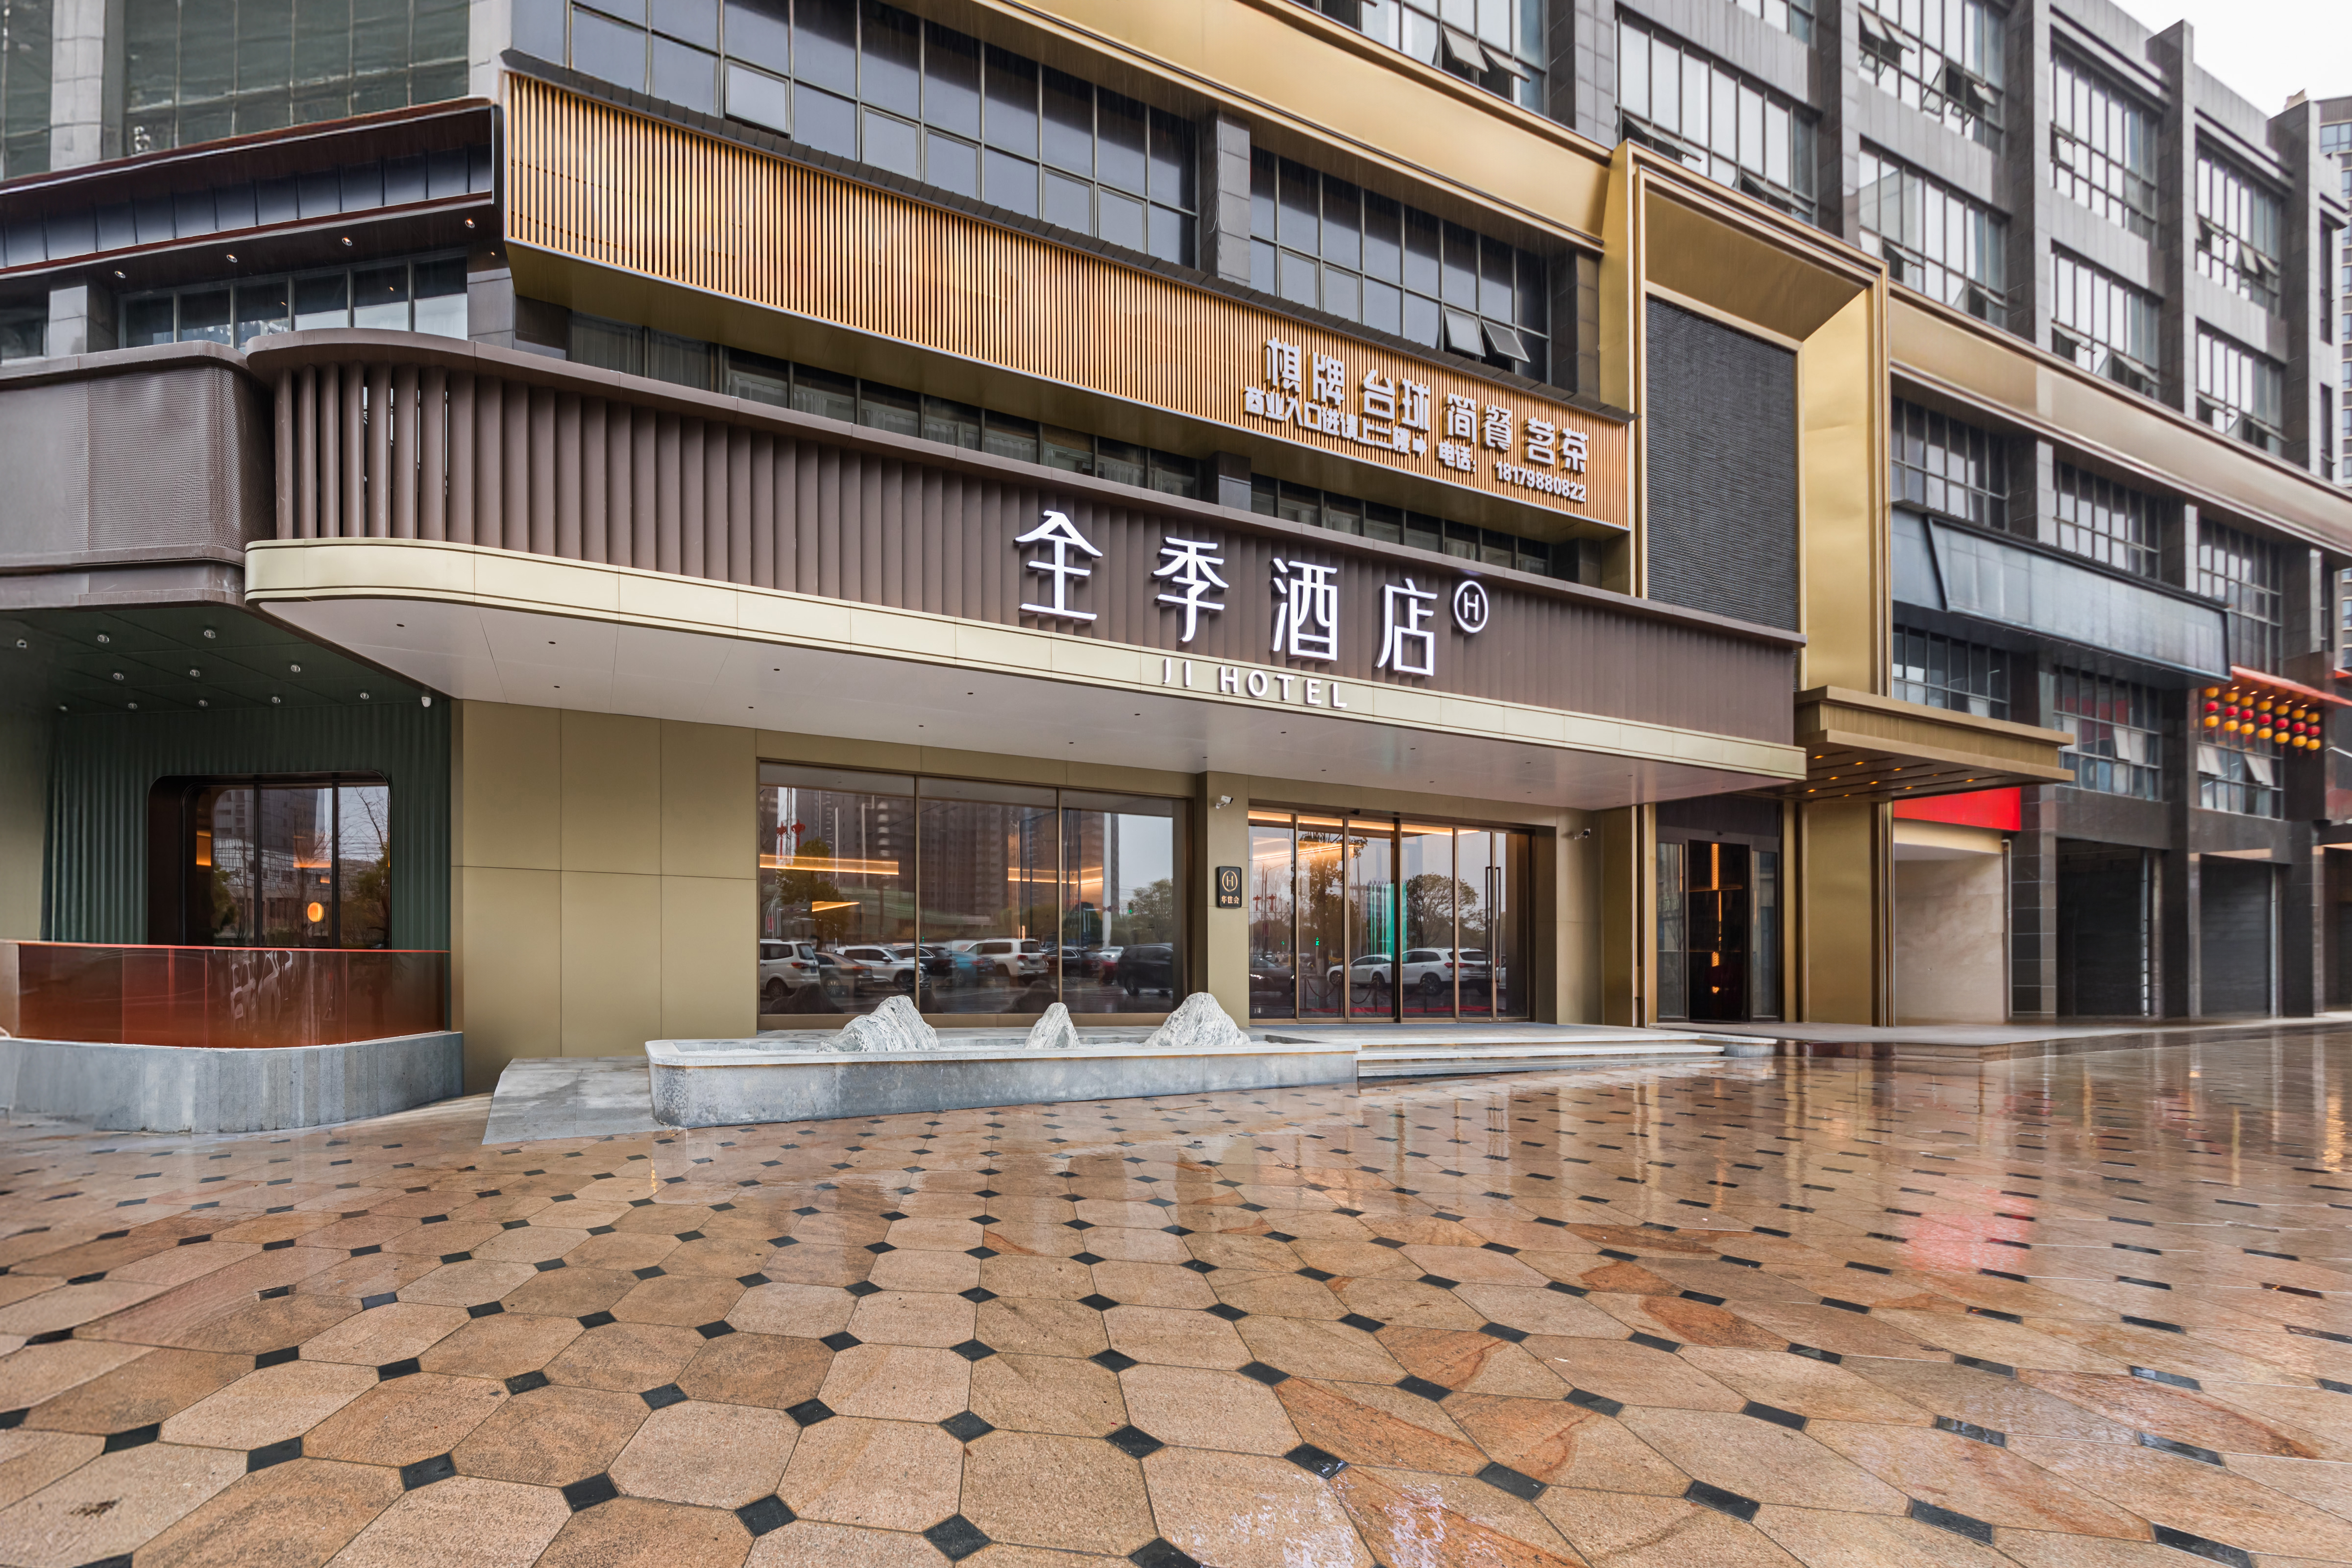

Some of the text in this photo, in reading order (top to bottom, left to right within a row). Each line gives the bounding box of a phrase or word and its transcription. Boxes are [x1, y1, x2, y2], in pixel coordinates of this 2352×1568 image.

[1496, 461, 1587, 503] 18179880822
[1014, 510, 1437, 677] 全季酒店
[1163, 658, 1348, 709] JI HOTEL
[1221, 895, 1240, 904] 华住会
